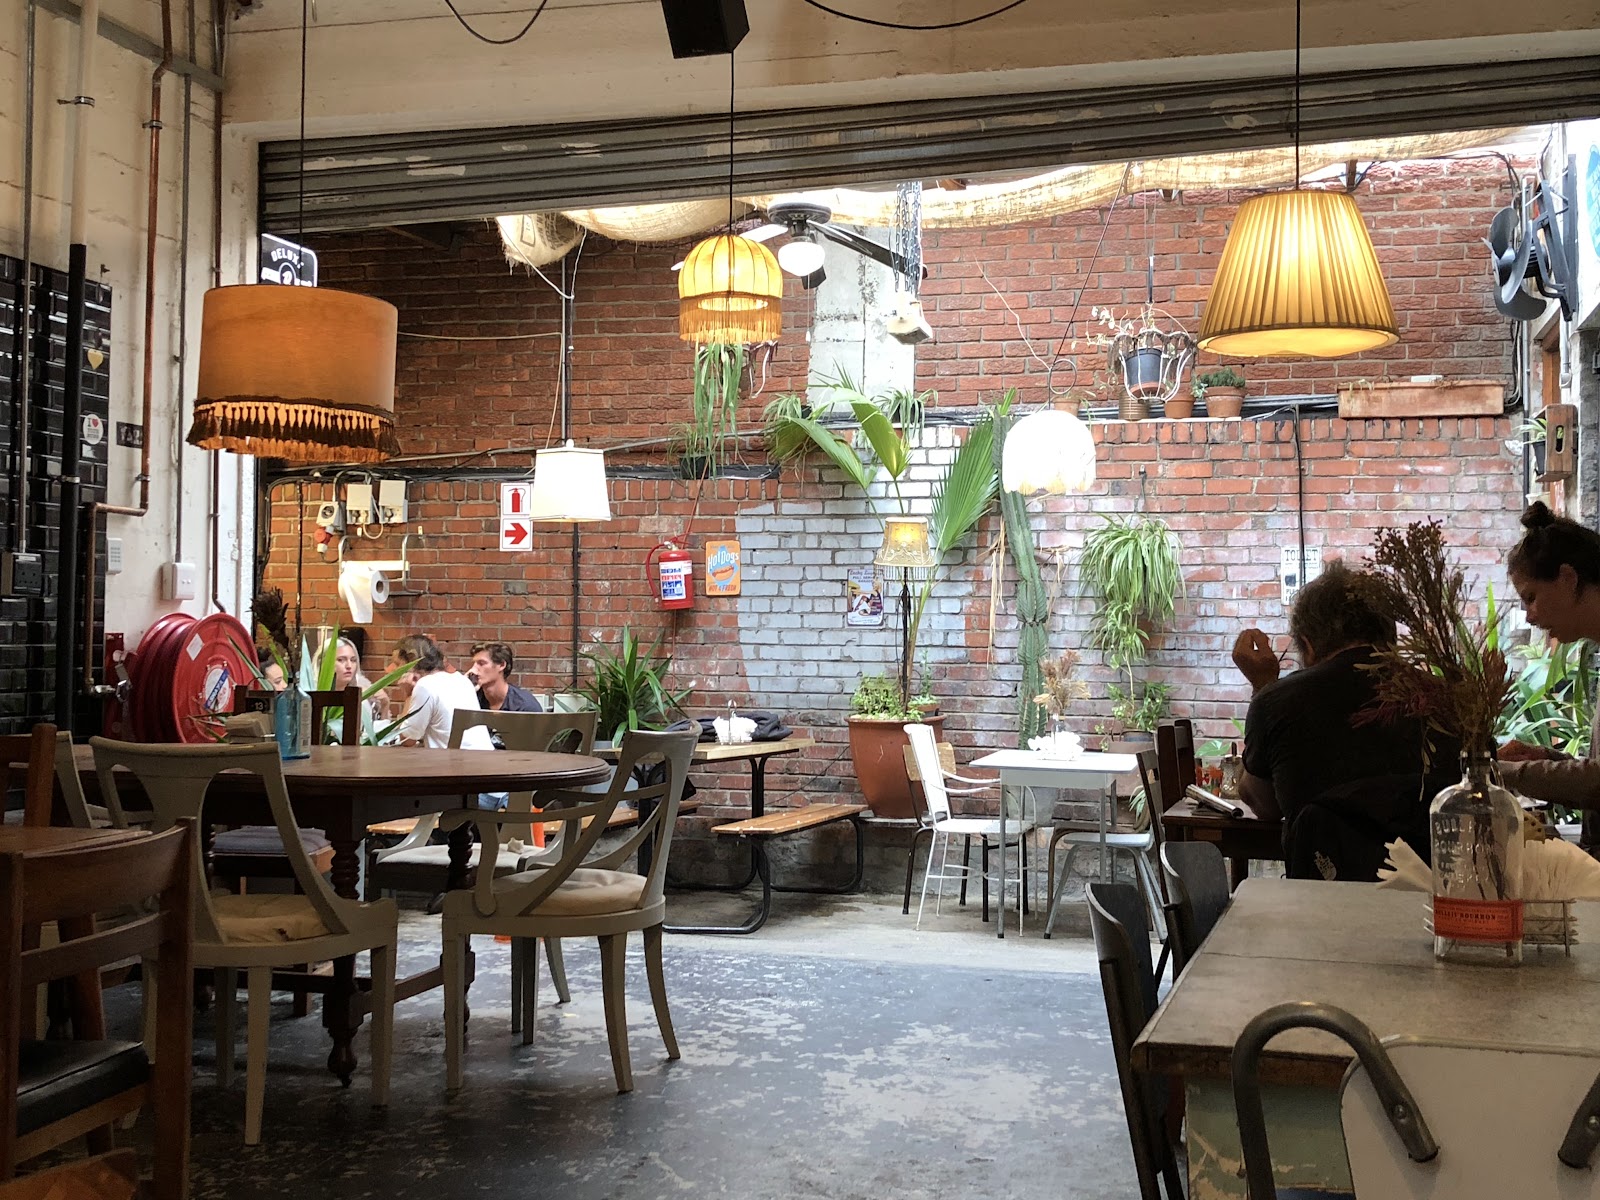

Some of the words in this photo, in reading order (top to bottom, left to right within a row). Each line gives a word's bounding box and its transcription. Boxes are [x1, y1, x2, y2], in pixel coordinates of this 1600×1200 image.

[1285, 549, 1318, 561] TOIET
[254, 701, 264, 710] 13
[1460, 912, 1496, 921] BOURBON
